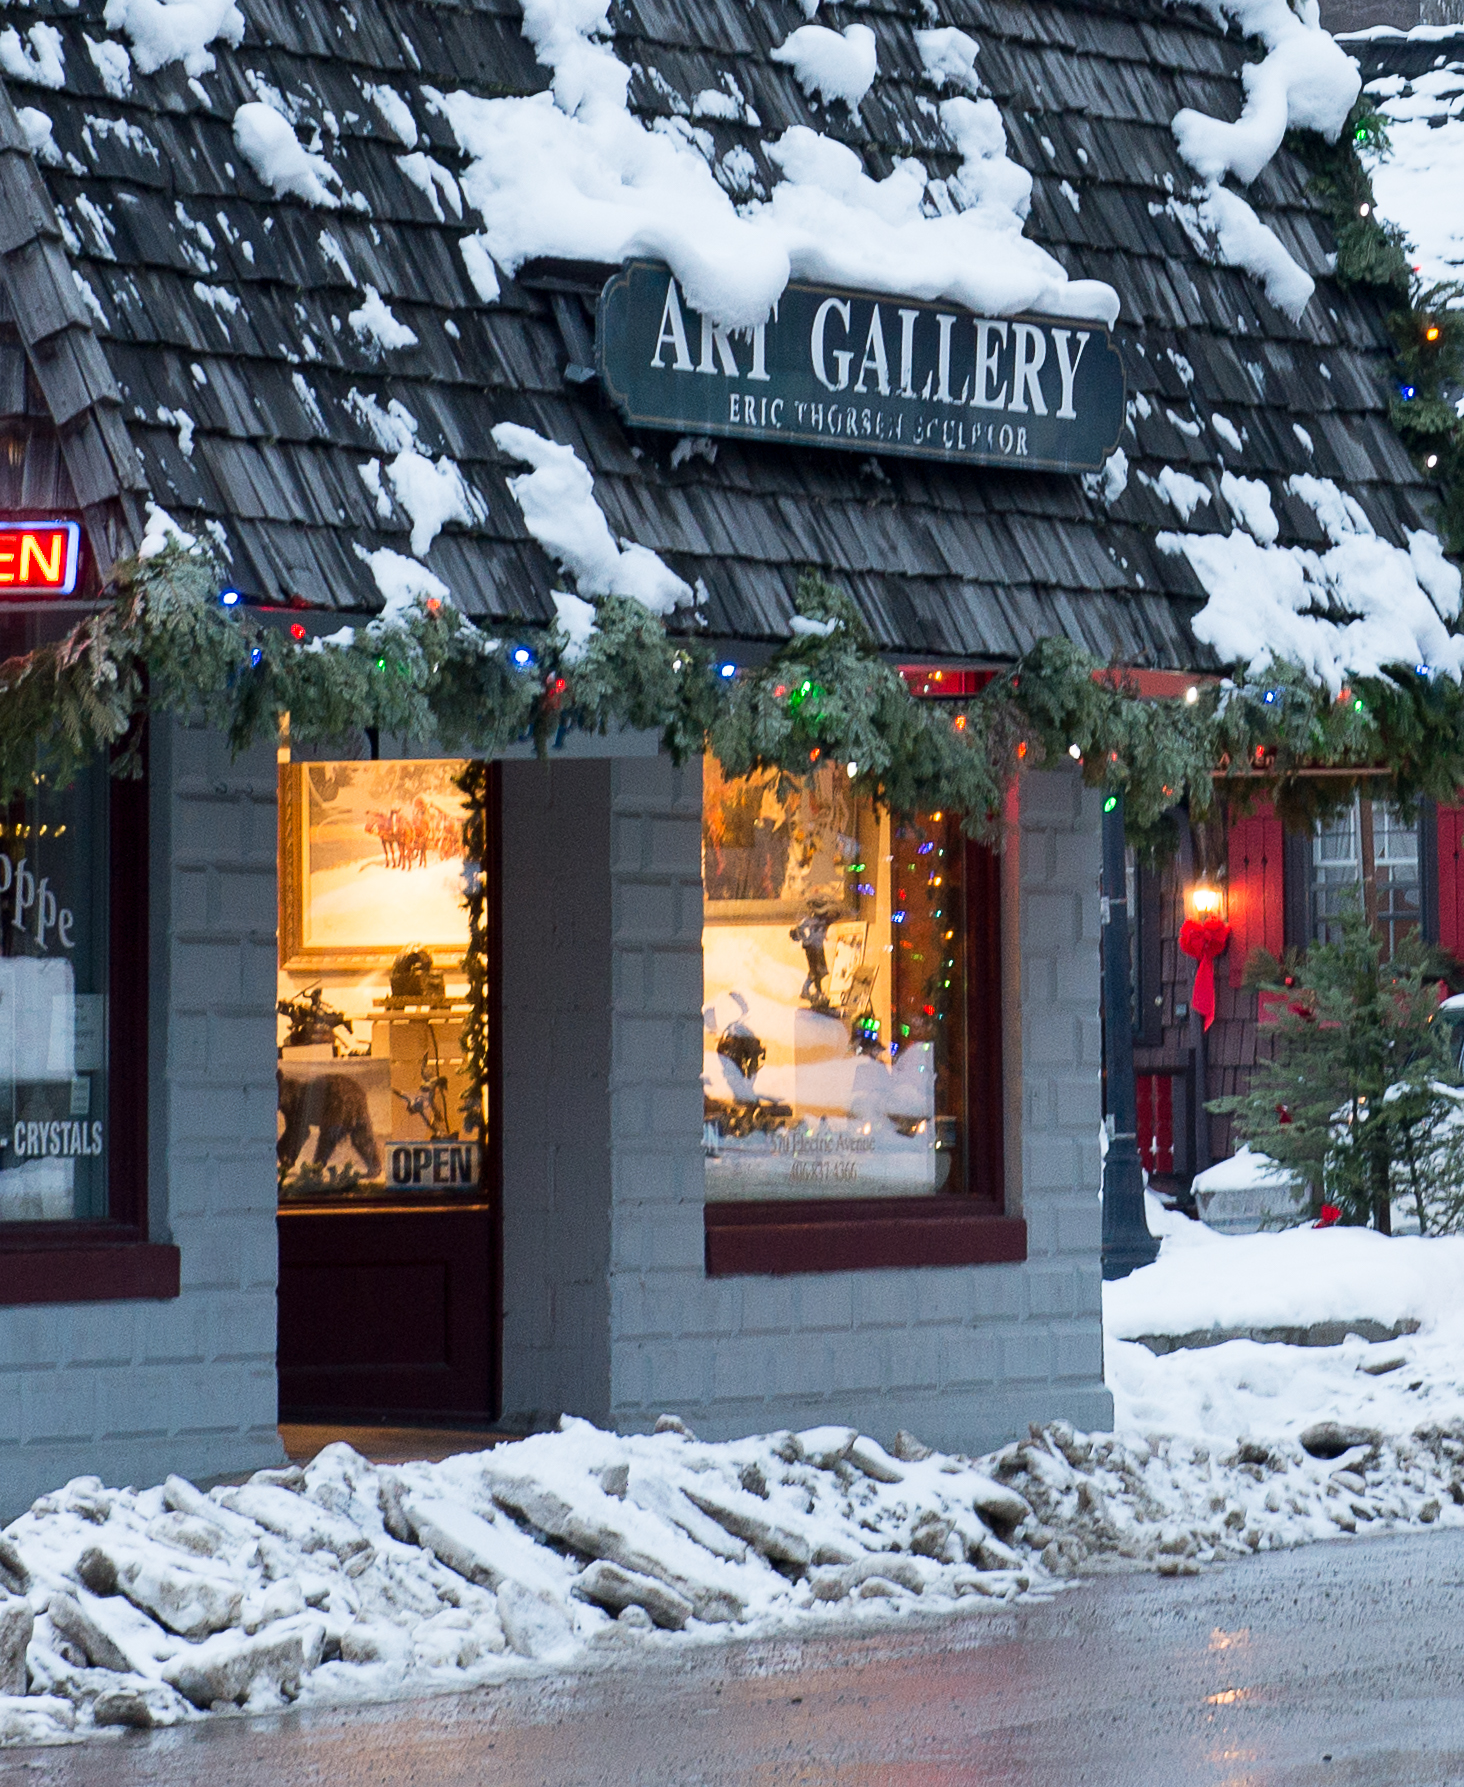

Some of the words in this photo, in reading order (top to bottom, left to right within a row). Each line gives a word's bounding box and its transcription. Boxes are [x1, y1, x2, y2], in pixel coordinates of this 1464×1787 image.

[809, 297, 1091, 421] GALLERY
[729, 393, 785, 429] ERIC
[13, 1120, 103, 1156] CRYSTALS
[392, 1146, 472, 1184] OPEN
